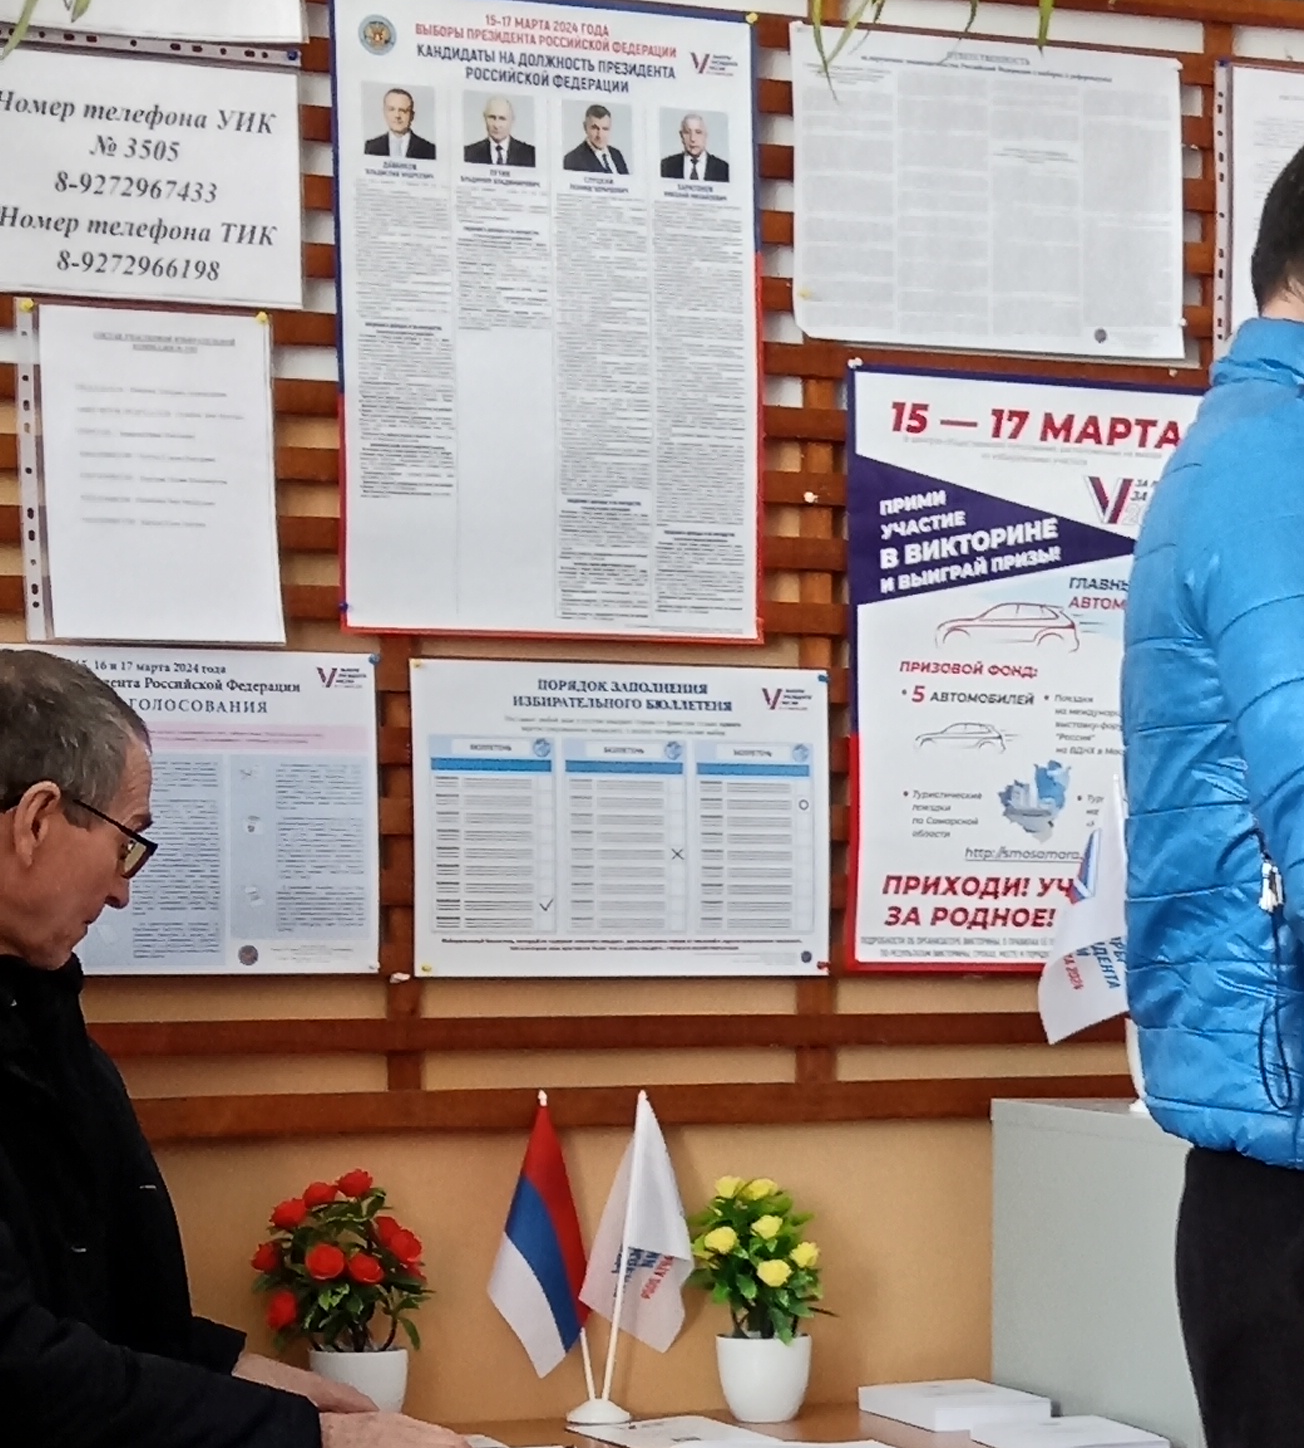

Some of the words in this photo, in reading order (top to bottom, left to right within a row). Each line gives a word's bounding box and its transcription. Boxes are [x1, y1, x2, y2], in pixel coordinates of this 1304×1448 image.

[415, 23, 464, 39] ВЫБОРЫ
[467, 27, 536, 46] ПРЕЗИДЕНТА
[539, 33, 610, 52] РОССИЙСКОЙ
[612, 41, 677, 59] ФЕДЕРАЦИИ
[515, 18, 550, 31] МАРТА
[553, 21, 579, 34] 2024
[582, 23, 609, 37] ГОДА
[417, 43, 495, 65] КАНДИДАТЫ
[499, 51, 516, 65] НА
[518, 52, 595, 74] ДОЛЖНОСТЬ
[598, 60, 675, 80] ПРЕЗИДЕНТА
[465, 65, 549, 87] РОССИЙСКОЙ
[552, 74, 629, 93] ФЕДЕРАЦИИ
[0, 90, 75, 122] Номер
[84, 104, 207, 129] телефона
[217, 109, 277, 134] УИК
[90, 135, 117, 157] №
[124, 138, 180, 162] 3505
[55, 171, 217, 203] 8-9272967433
[0, 206, 79, 238] Номер
[87, 218, 210, 244] телефона
[221, 222, 278, 246] ТИК
[57, 250, 220, 281] 8-9272966198
[891, 401, 929, 434] 15
[991, 408, 1029, 439] 17
[1040, 412, 1181, 449] МАРТА
[880, 490, 946, 515] ПРИМИ
[881, 511, 966, 540] УЧАСТИЕ
[880, 547, 899, 569] В
[905, 517, 1059, 565] ВИКТОРИНЕ
[880, 577, 895, 594] И
[898, 557, 988, 590] ВЫИГРАЙ
[991, 546, 1062, 573] ПРИЗЫ!
[94, 659, 107, 670] 16
[121, 661, 133, 671] 17
[136, 663, 171, 674] марта
[173, 662, 199, 673] 2024
[201, 665, 227, 674] года
[899, 660, 983, 675] ПРИЗОВОЙ
[988, 664, 1038, 679] ФОНД:
[144, 677, 223, 691] Российской
[226, 679, 301, 695] Федерации
[537, 679, 609, 693] ПОРЯДОК
[611, 681, 708, 695] ЗАПОЛНЕНИЯ
[912, 685, 925, 703] 5
[930, 691, 1035, 705] АВТОМОБИЛЕЙ
[129, 698, 268, 714] ГОЛОСОВАНИЯ
[513, 695, 642, 709] ИЗБИРАТЕЛЬНОГО
[646, 698, 733, 712] БЮЛЛЕТЕНЯ
[882, 875, 1031, 899] ПРИХОДИ!
[884, 906, 921, 926] ЗА
[930, 907, 1057, 930] РОДНОЕ!
